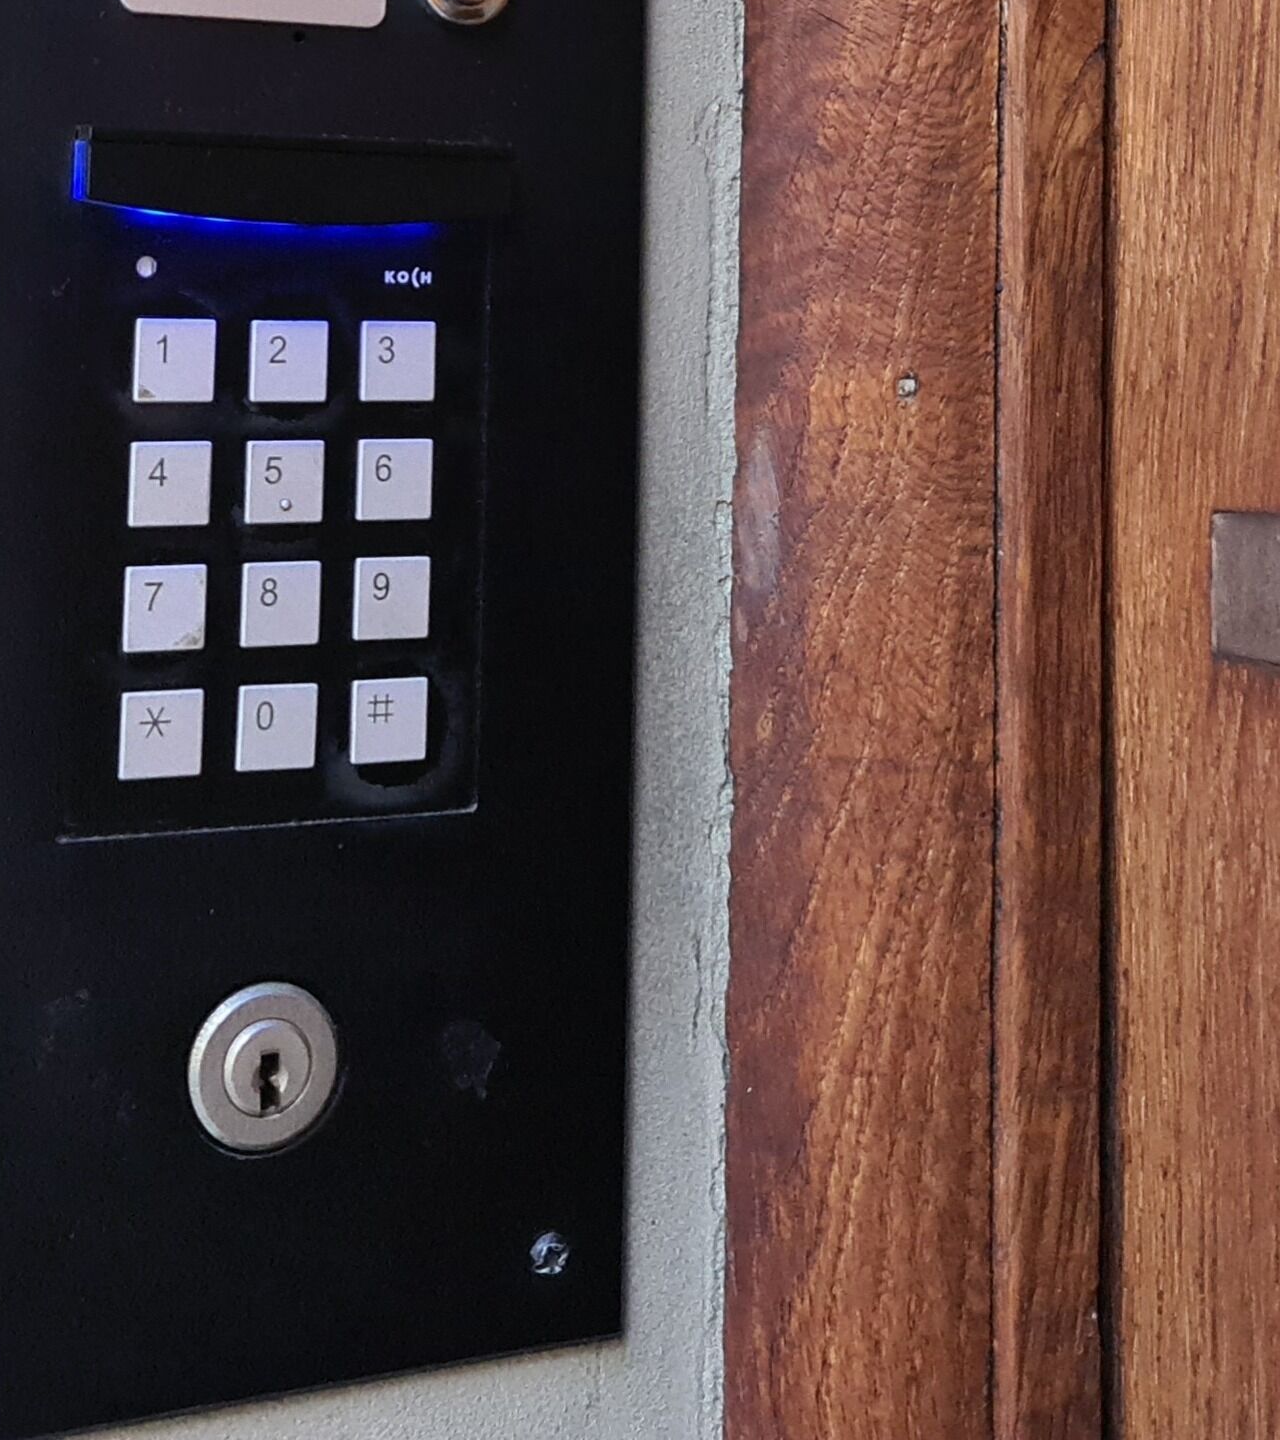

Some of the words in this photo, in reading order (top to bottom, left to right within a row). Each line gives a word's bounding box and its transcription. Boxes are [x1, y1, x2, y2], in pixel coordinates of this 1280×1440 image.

[156, 334, 169, 364] 1
[268, 335, 287, 364] 2
[377, 335, 396, 365] 3
[147, 457, 168, 488] 4
[263, 456, 283, 486] 5
[374, 453, 393, 483] 6
[143, 581, 164, 612] 7
[259, 577, 279, 608] 8
[372, 571, 391, 601] 9
[255, 700, 275, 731] 0
